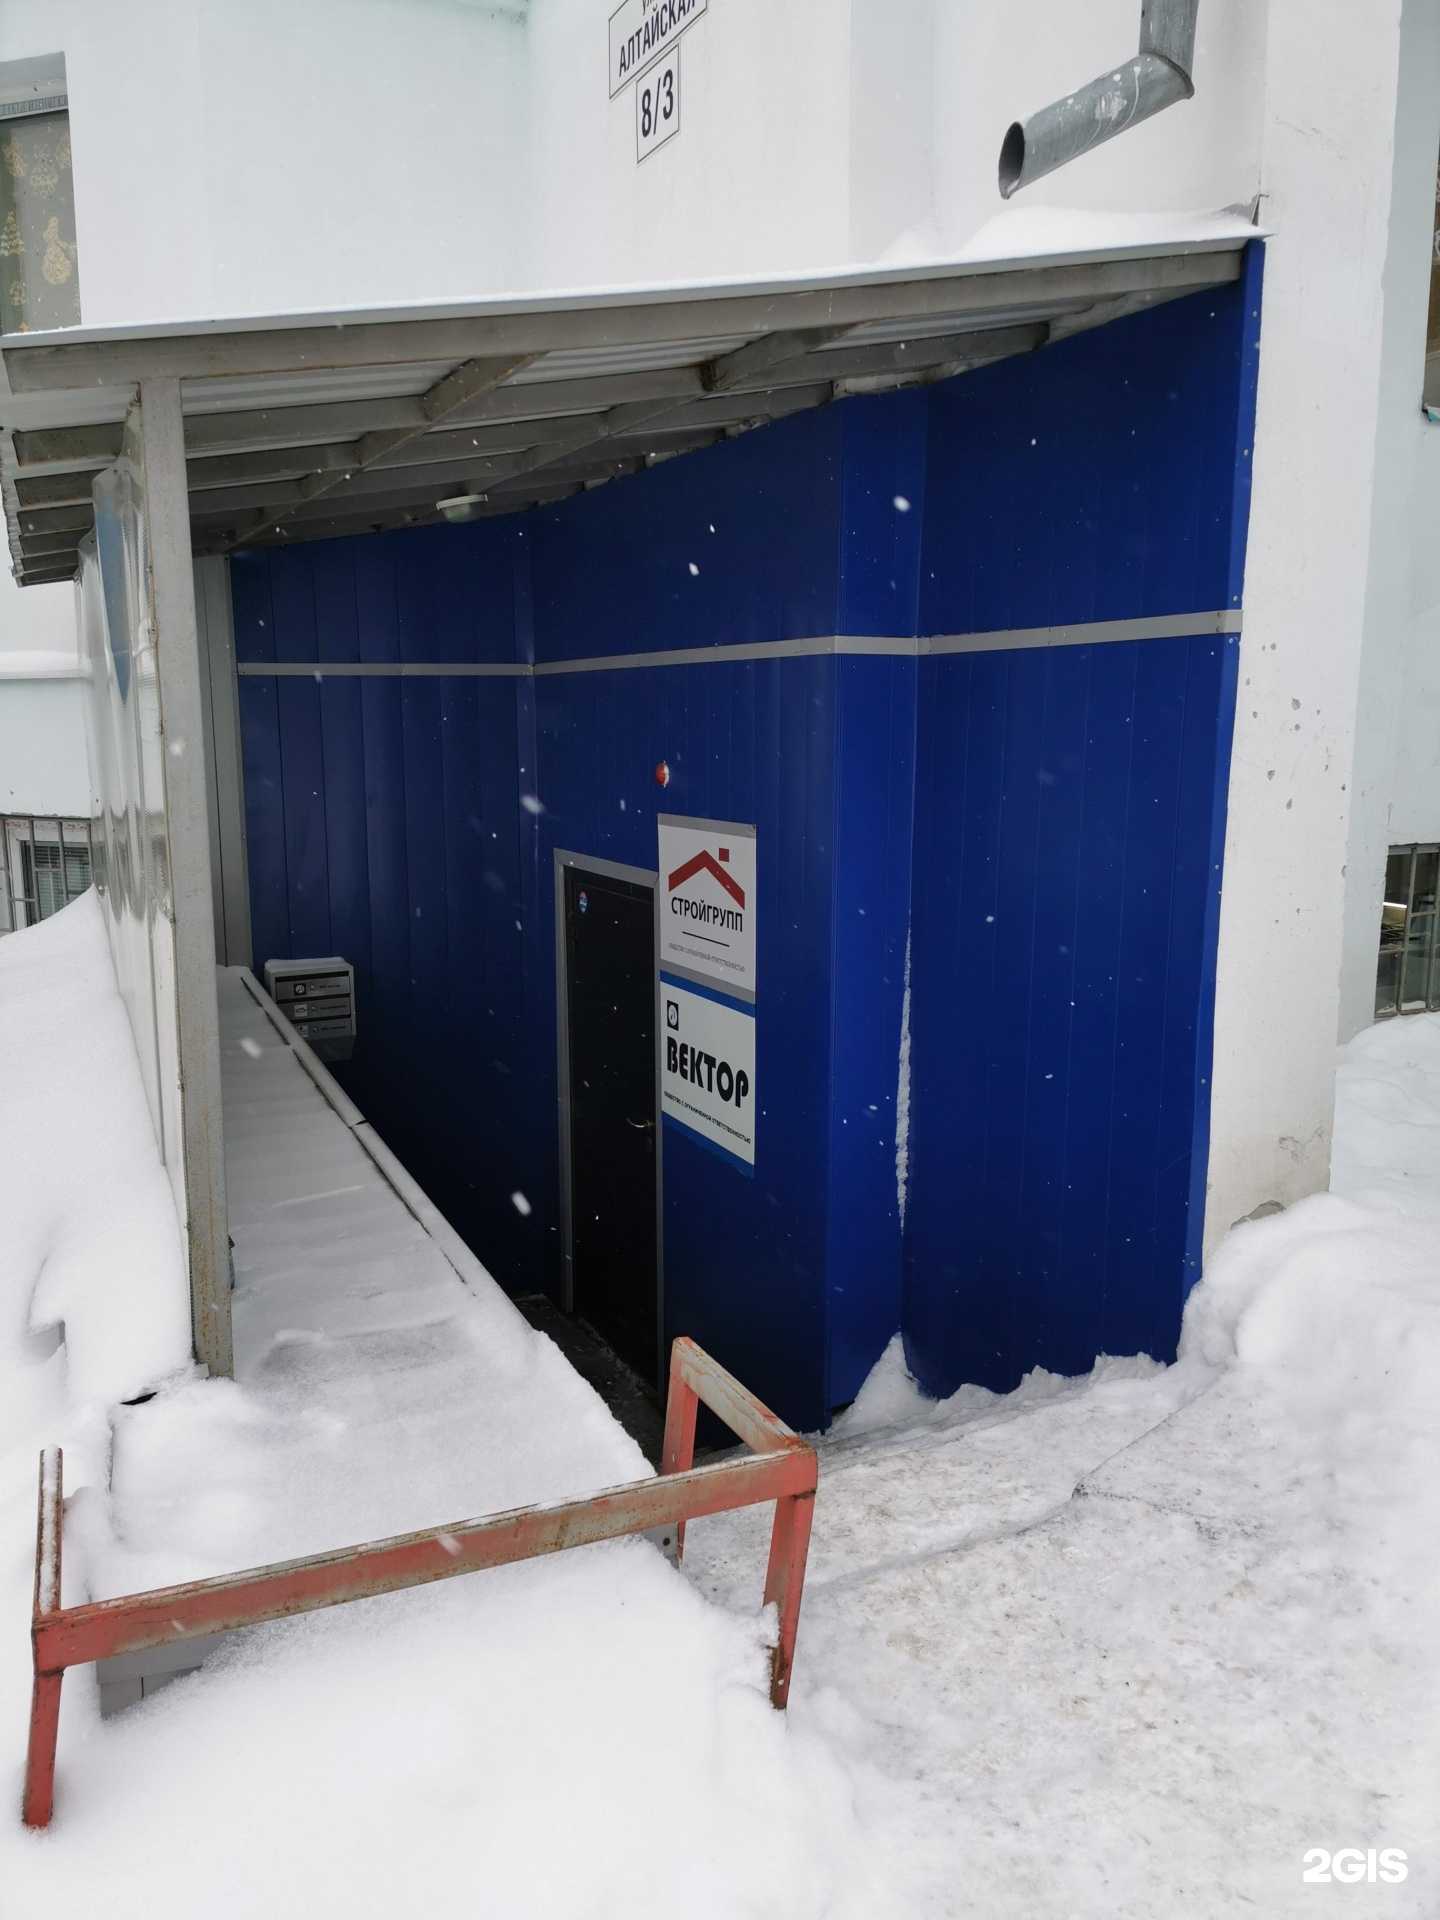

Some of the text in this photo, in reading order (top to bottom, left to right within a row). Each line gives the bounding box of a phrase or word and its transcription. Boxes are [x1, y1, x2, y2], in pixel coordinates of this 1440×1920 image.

[641, 69, 674, 138] 8/3
[671, 896, 743, 933] СТРОЙГРУПП
[666, 1035, 749, 1108] ВЕКТОР
